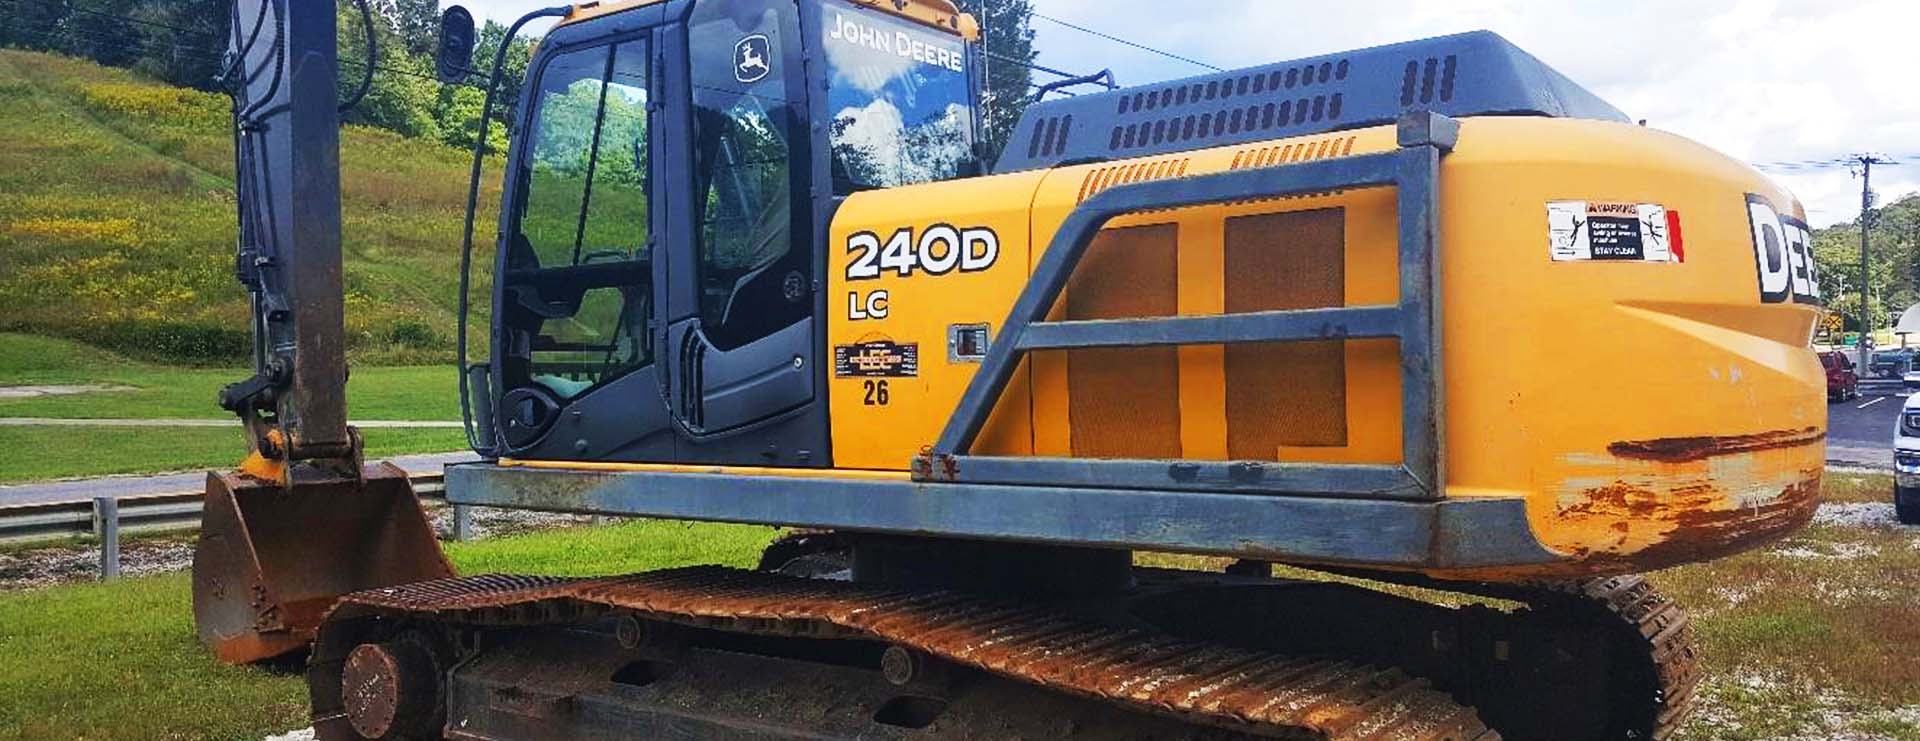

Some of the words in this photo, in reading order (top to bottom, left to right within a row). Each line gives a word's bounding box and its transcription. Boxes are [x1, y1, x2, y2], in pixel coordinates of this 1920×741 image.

[830, 13, 890, 52] JOHN
[895, 31, 963, 72] DEERE
[846, 223, 999, 281] 240D
[1594, 246, 1613, 255] STAY
[848, 290, 888, 320] LC
[864, 380, 888, 405] 26
